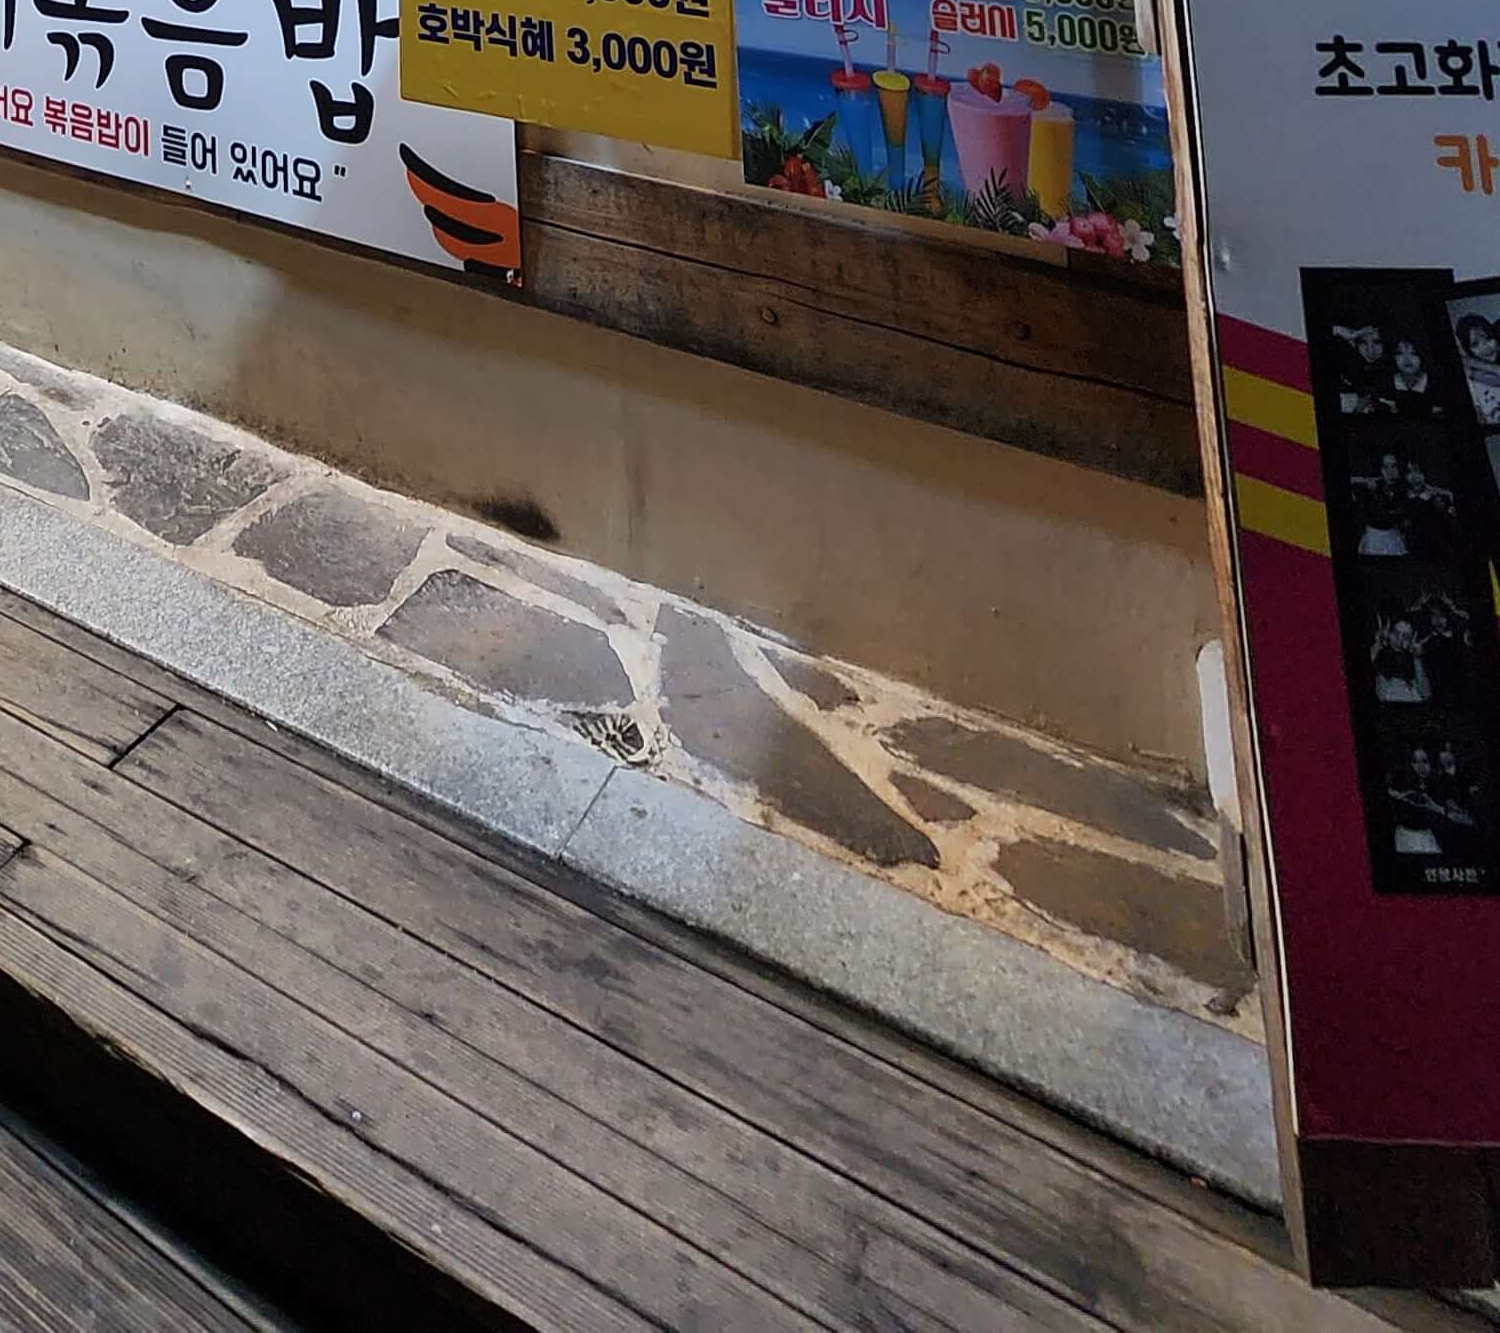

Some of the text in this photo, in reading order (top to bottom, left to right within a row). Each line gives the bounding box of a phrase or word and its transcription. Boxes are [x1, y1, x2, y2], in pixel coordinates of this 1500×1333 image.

[417, 3, 719, 90] 호박식혜 3,000원
[931, 0, 1146, 56] 슬러시 5,000원
[1314, 34, 1500, 101] 초고화
[44, 95, 150, 156] 볶음밥이
[161, 124, 218, 175] 들어
